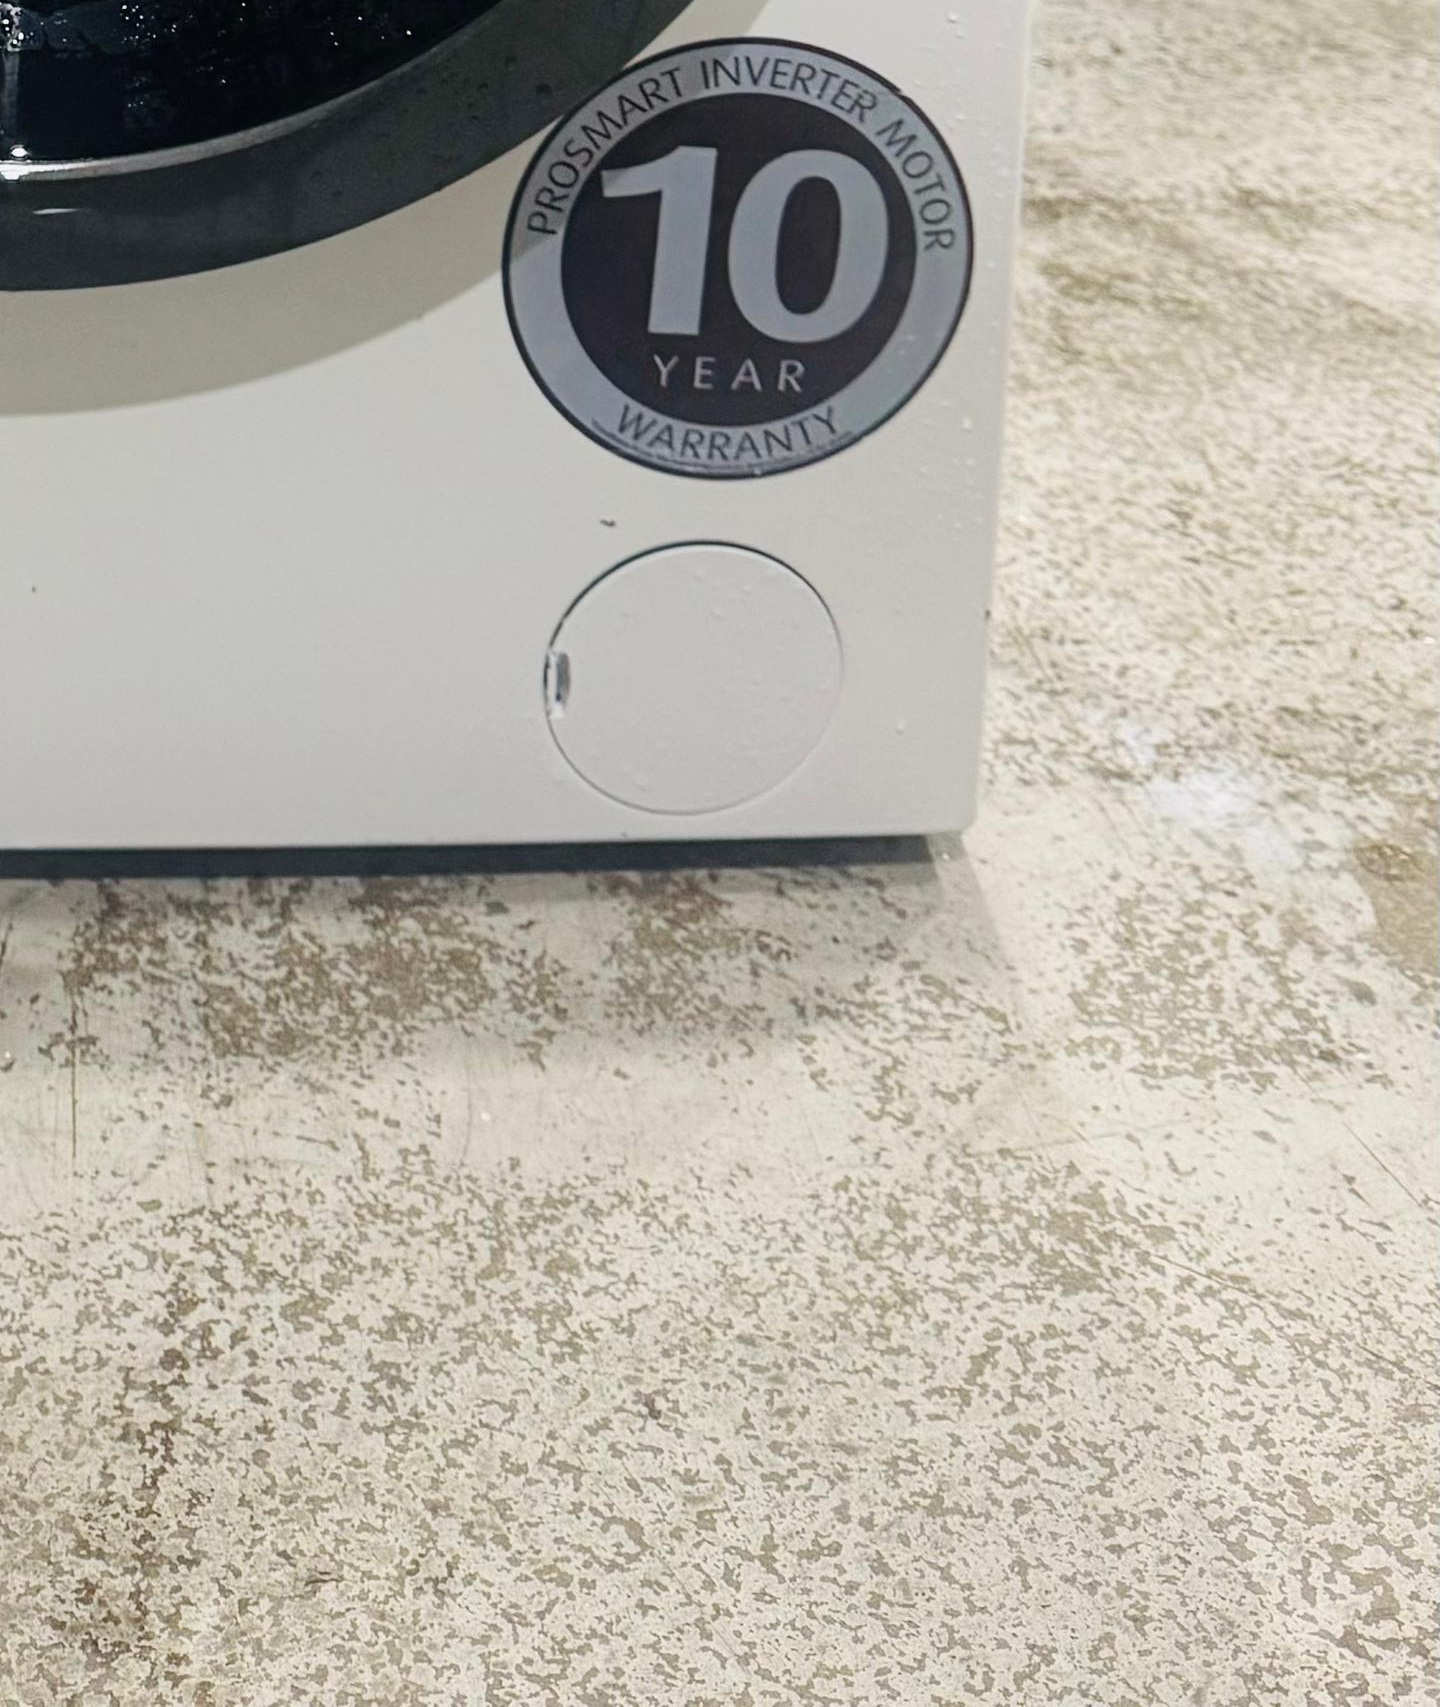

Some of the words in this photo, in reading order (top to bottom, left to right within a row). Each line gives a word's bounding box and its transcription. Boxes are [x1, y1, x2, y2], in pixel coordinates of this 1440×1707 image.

[528, 68, 684, 235] PROSMART
[700, 56, 878, 123] INVERTER
[875, 119, 956, 253] MOTOR
[601, 145, 889, 343] 10
[618, 404, 840, 462] WARRANTY
[654, 355, 805, 391] YEAR
